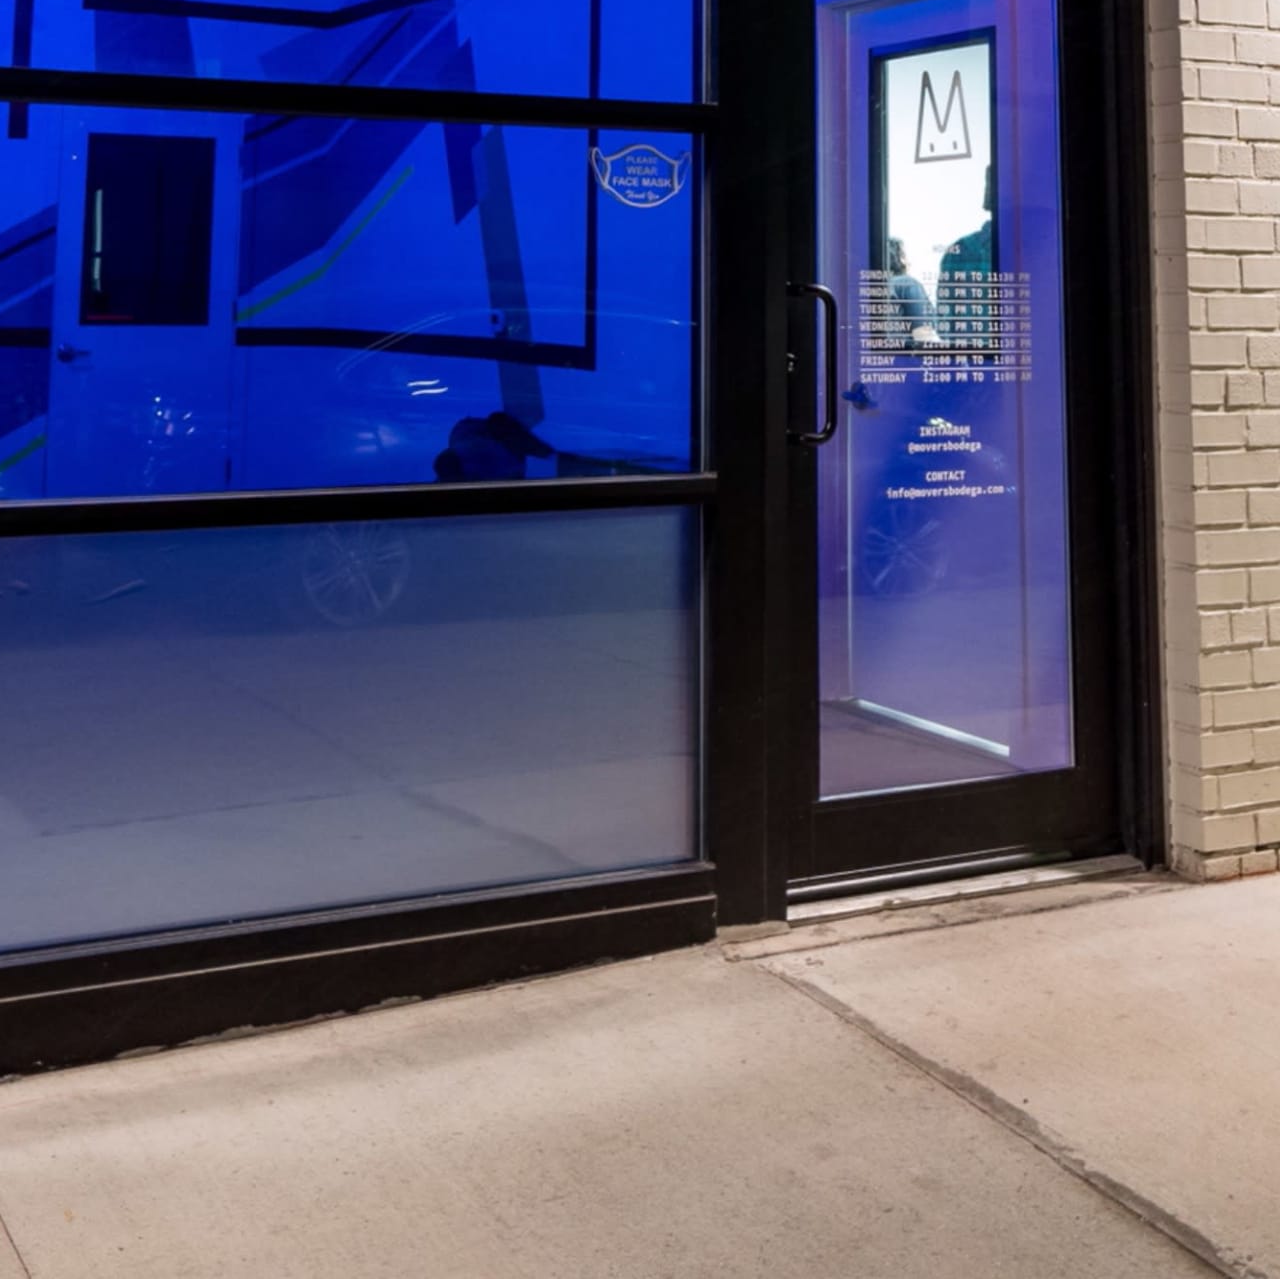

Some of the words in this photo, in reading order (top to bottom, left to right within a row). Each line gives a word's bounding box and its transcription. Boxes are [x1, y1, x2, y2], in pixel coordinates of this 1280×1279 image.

[626, 156, 657, 165] PLEASE
[626, 166, 657, 175] WEAR
[614, 176, 639, 186] FACE
[643, 178, 671, 187] MASK
[954, 271, 967, 282] PM
[971, 271, 983, 282] TO
[954, 287, 967, 298] PM
[971, 287, 983, 298] TO
[860, 304, 900, 315] TUESDAY
[954, 304, 967, 315] PM
[971, 304, 983, 315] TO
[860, 321, 912, 331] WEDNESDAY
[955, 321, 967, 332] PM
[972, 321, 983, 332] TO
[860, 338, 906, 349] THURSDAY
[955, 339, 967, 349] PM
[972, 339, 984, 349] TO
[861, 355, 896, 366] FRIDAY
[923, 355, 951, 366] 12:00
[956, 355, 968, 366] PM
[972, 355, 984, 366] TO
[861, 372, 907, 384] SATURDAY
[923, 372, 951, 383] 12:00
[956, 372, 968, 383] PM
[972, 372, 984, 383] TO
[920, 425, 971, 437] INSTAGRAM
[925, 470, 966, 482] CONTACT
